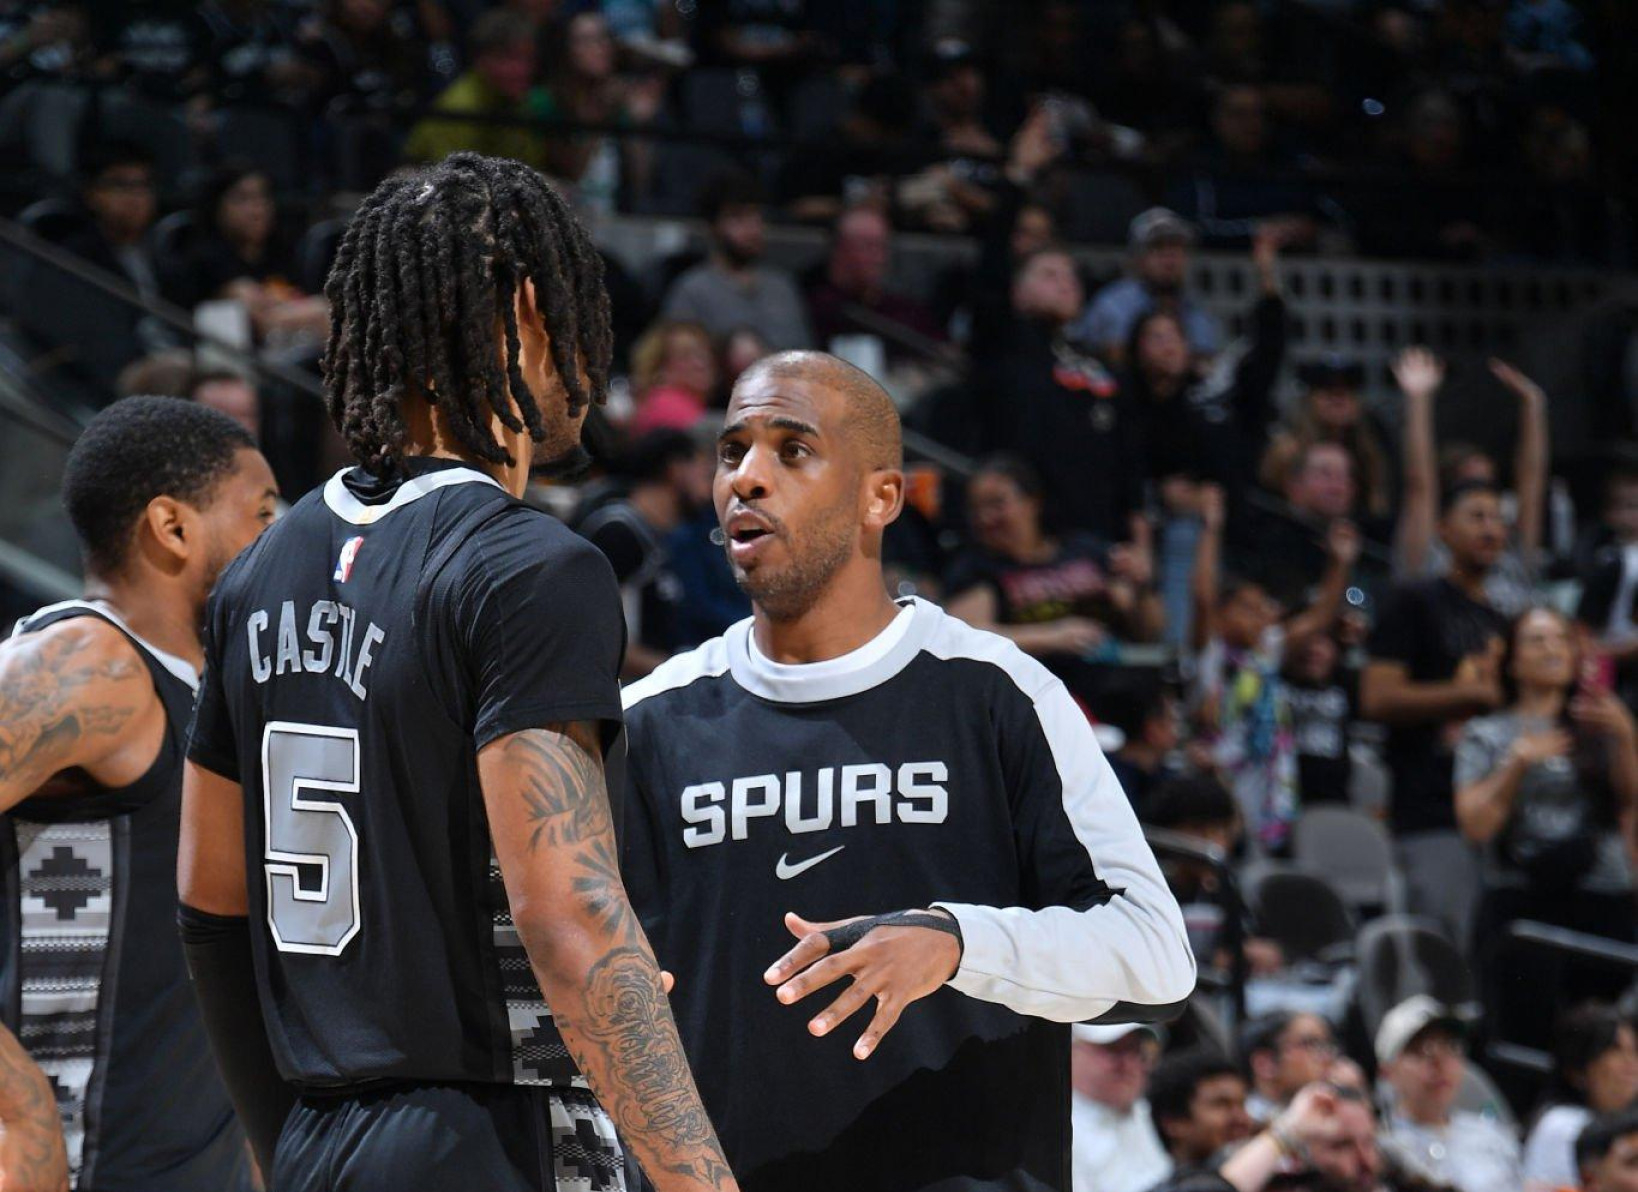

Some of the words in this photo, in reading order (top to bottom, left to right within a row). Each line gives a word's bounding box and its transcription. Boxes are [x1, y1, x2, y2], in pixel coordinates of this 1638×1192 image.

[246, 600, 386, 702] CASTLE
[262, 720, 361, 957] 5
[681, 761, 949, 849] SPURS
